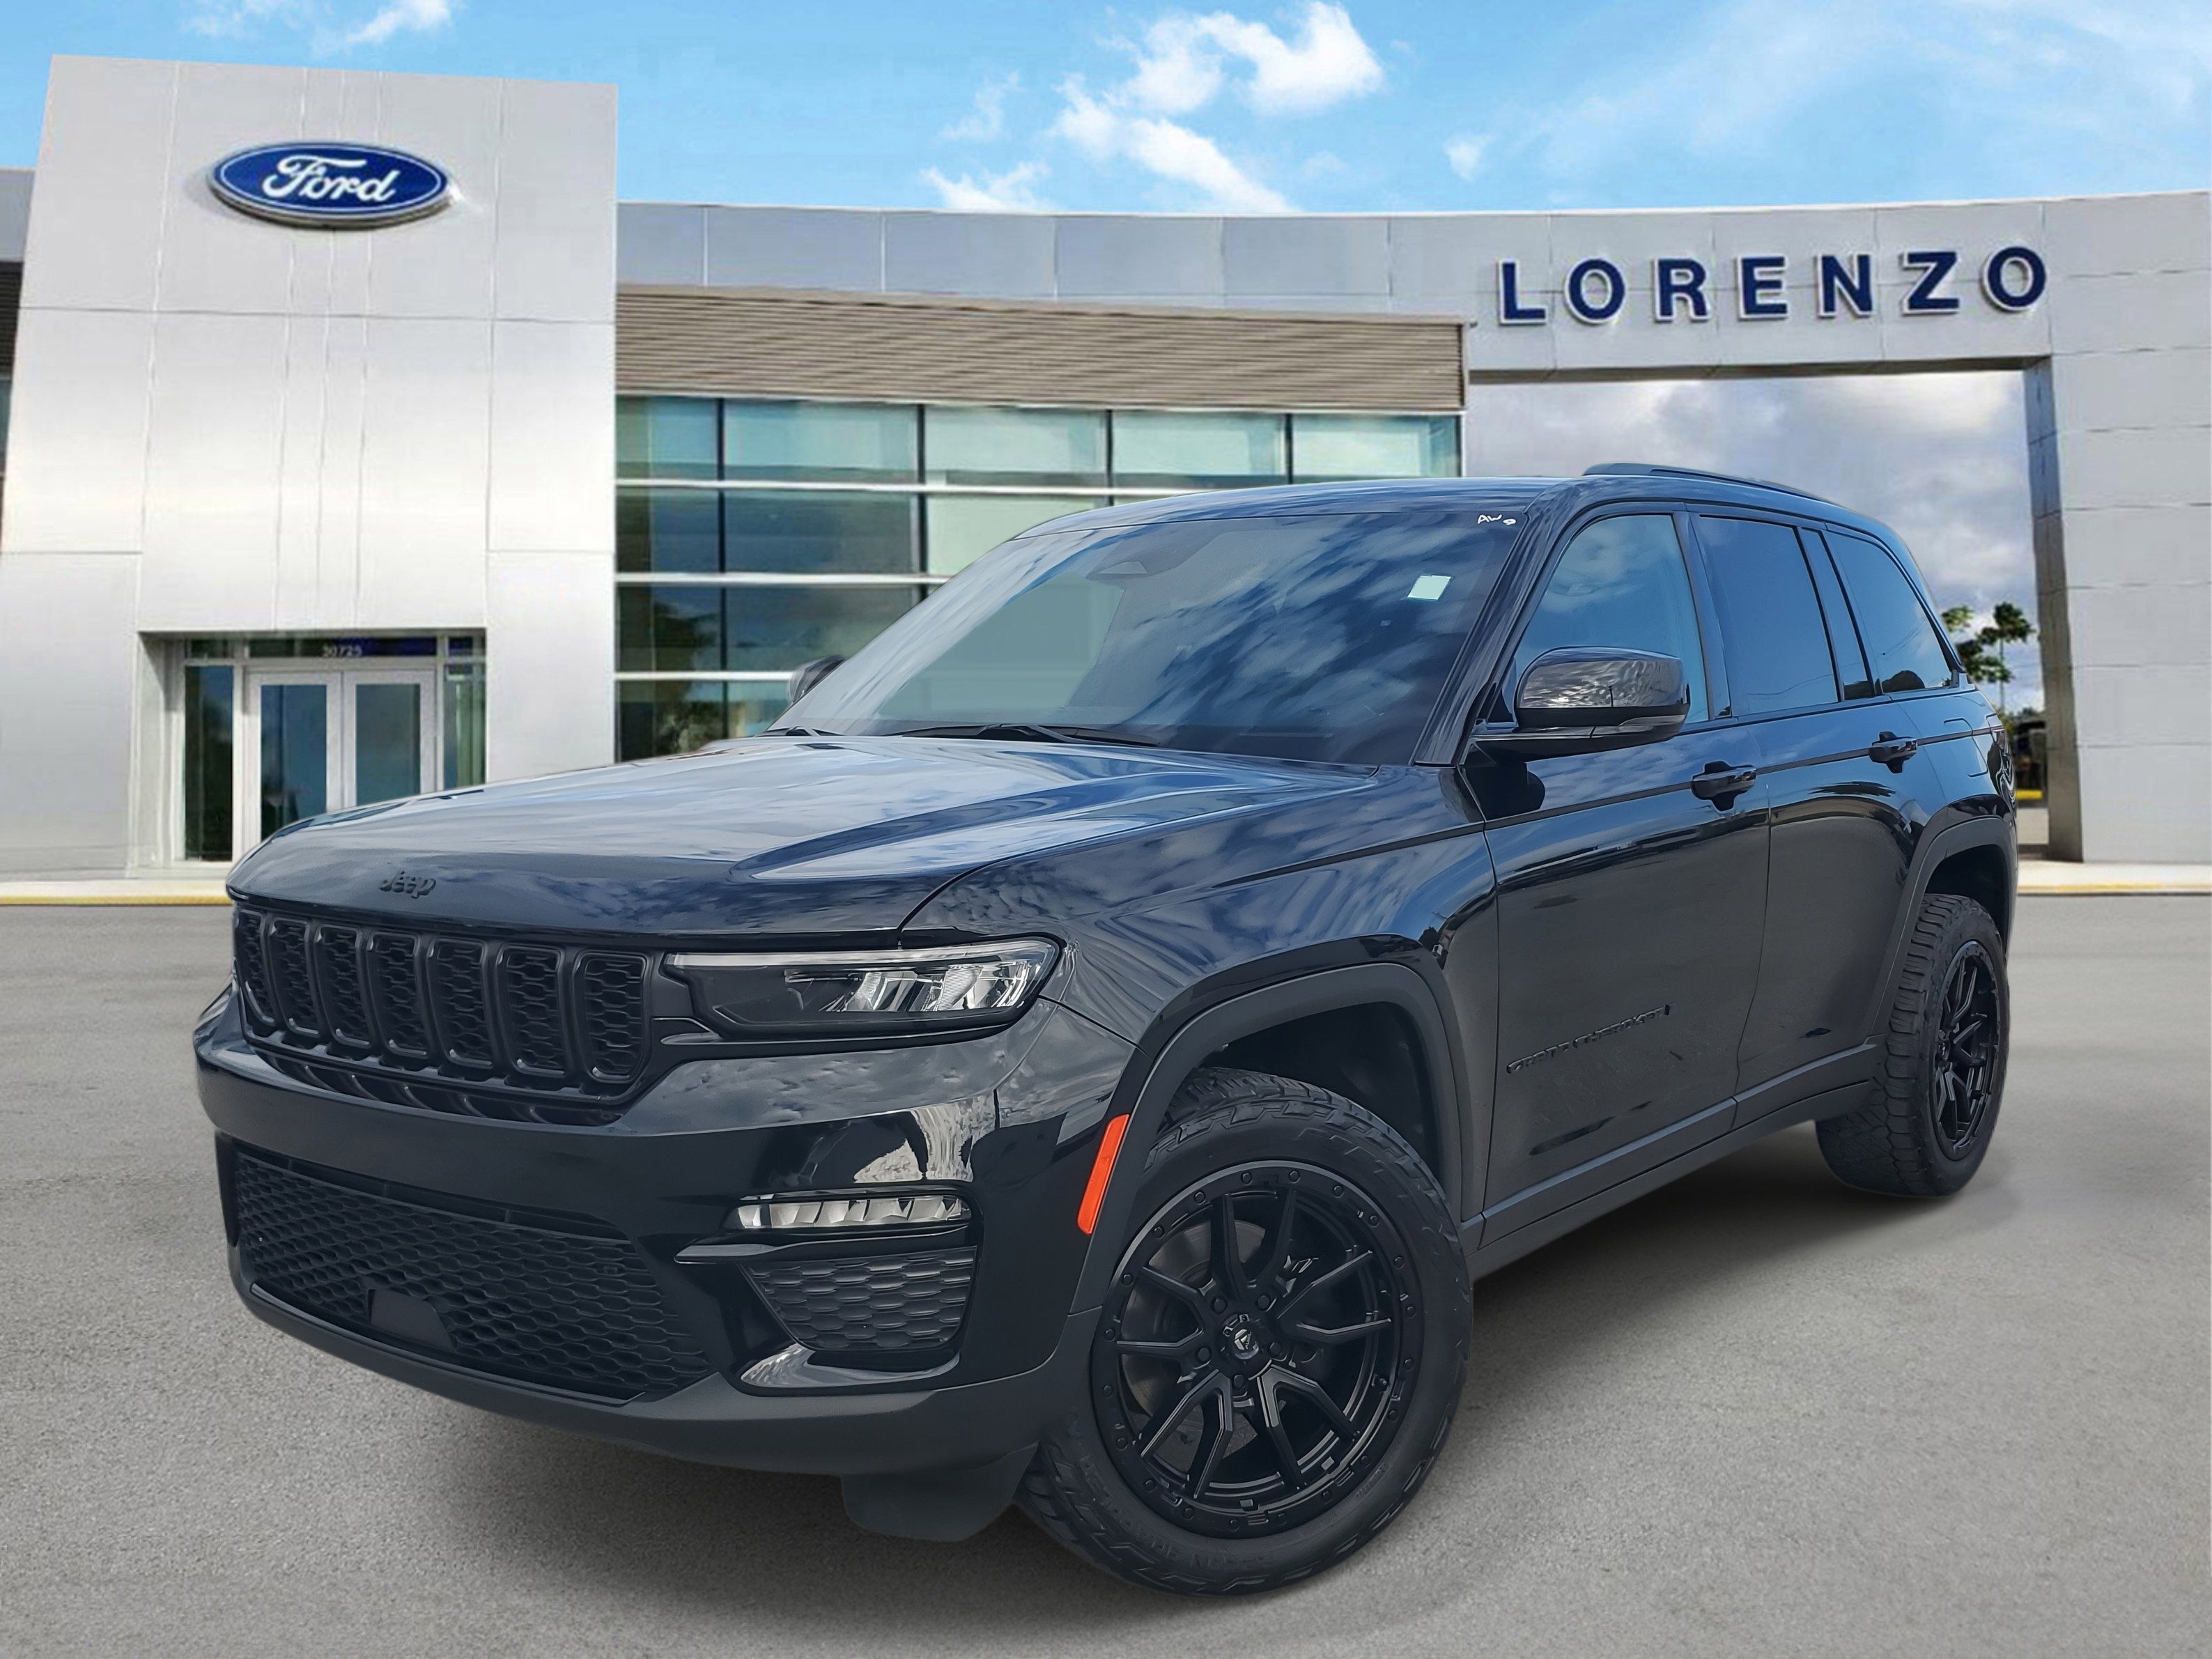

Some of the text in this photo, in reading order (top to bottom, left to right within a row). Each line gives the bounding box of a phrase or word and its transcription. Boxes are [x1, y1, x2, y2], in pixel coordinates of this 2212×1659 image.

[262, 155, 401, 202] Ford
[1497, 245, 2048, 325] LORENZO
[379, 870, 436, 900] Jeep
